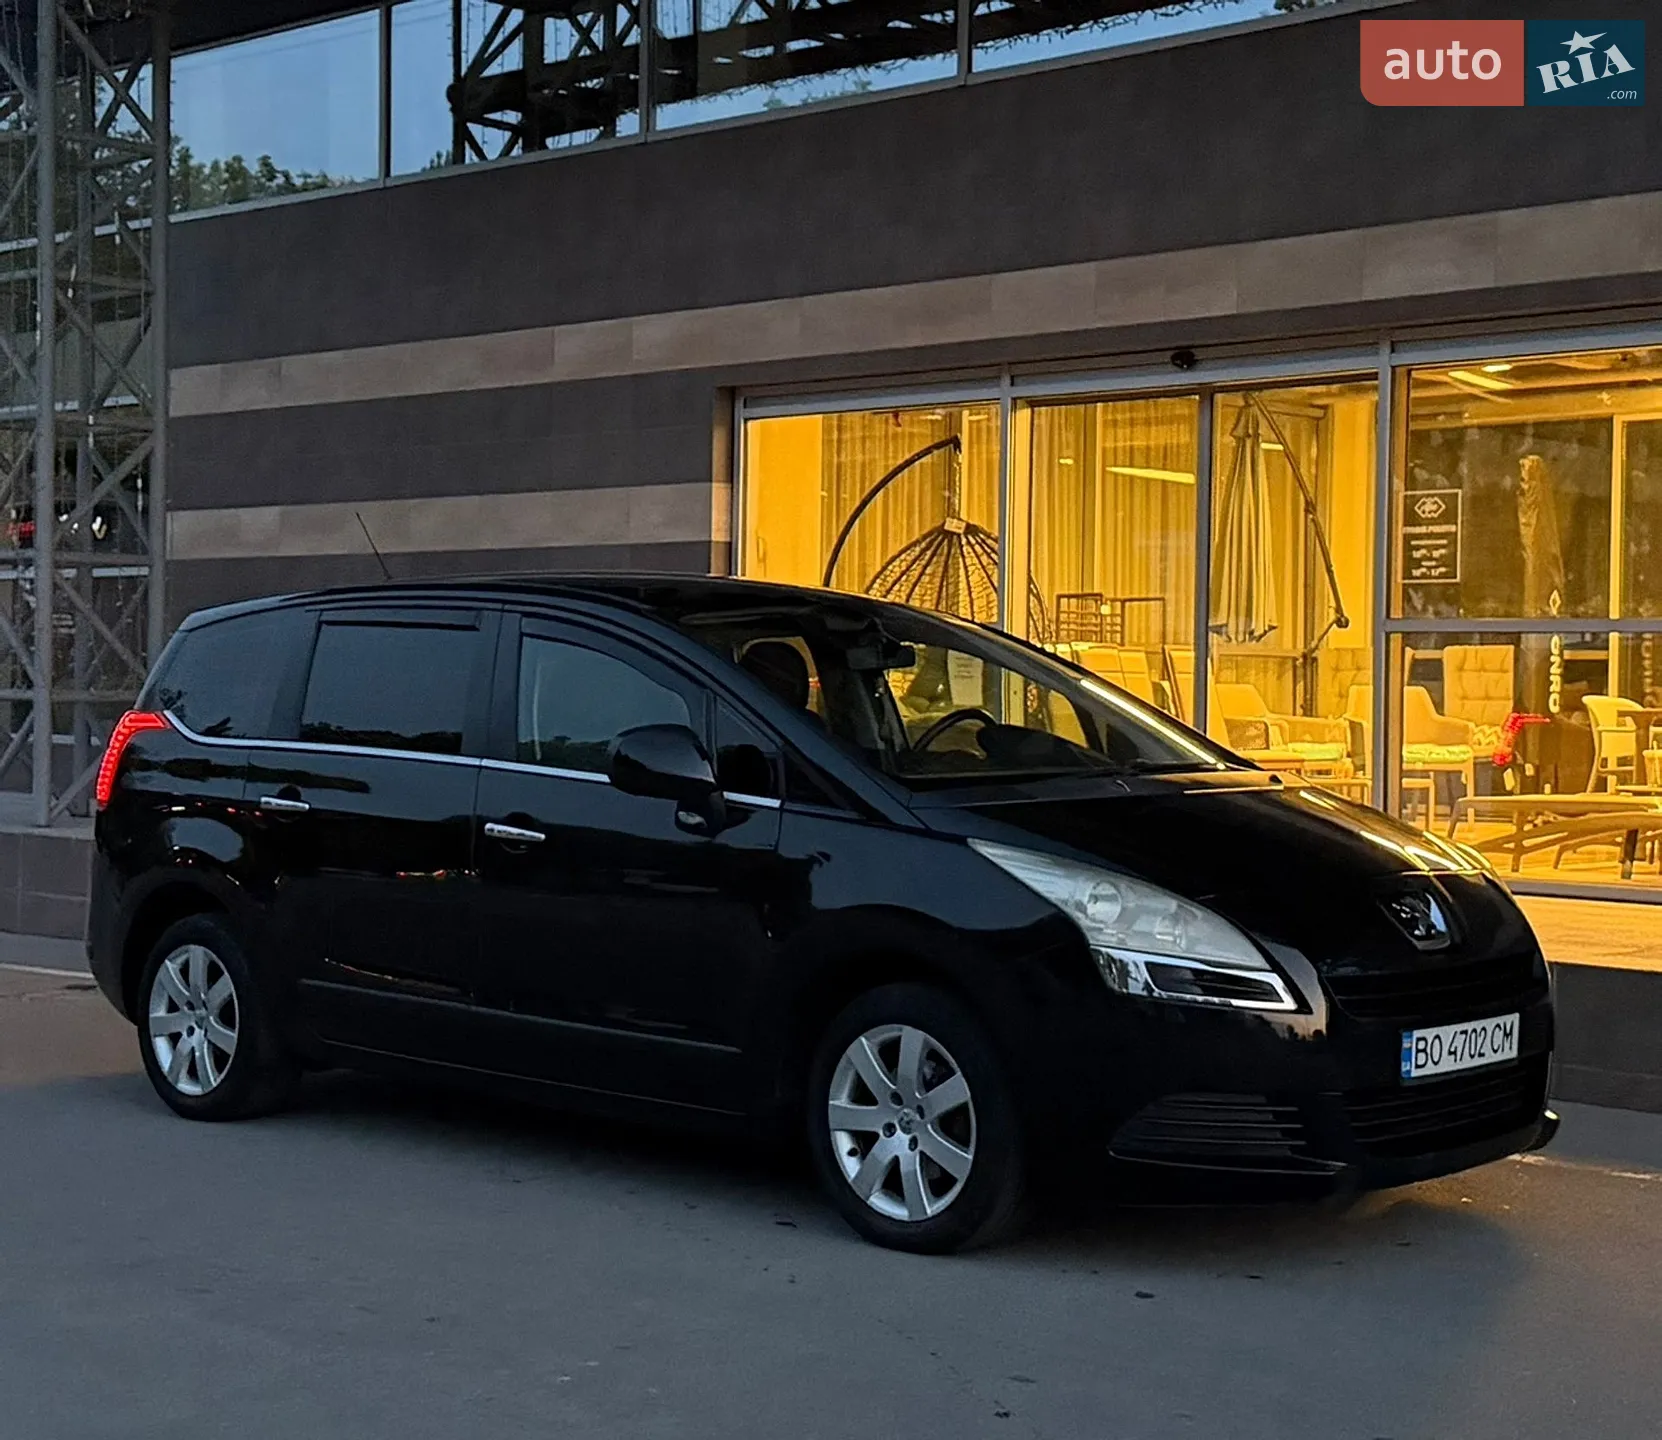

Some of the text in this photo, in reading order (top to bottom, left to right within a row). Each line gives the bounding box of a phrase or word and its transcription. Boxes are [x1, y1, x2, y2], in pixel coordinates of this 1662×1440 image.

[1414, 1020, 1514, 1070] BO 4702 CM
